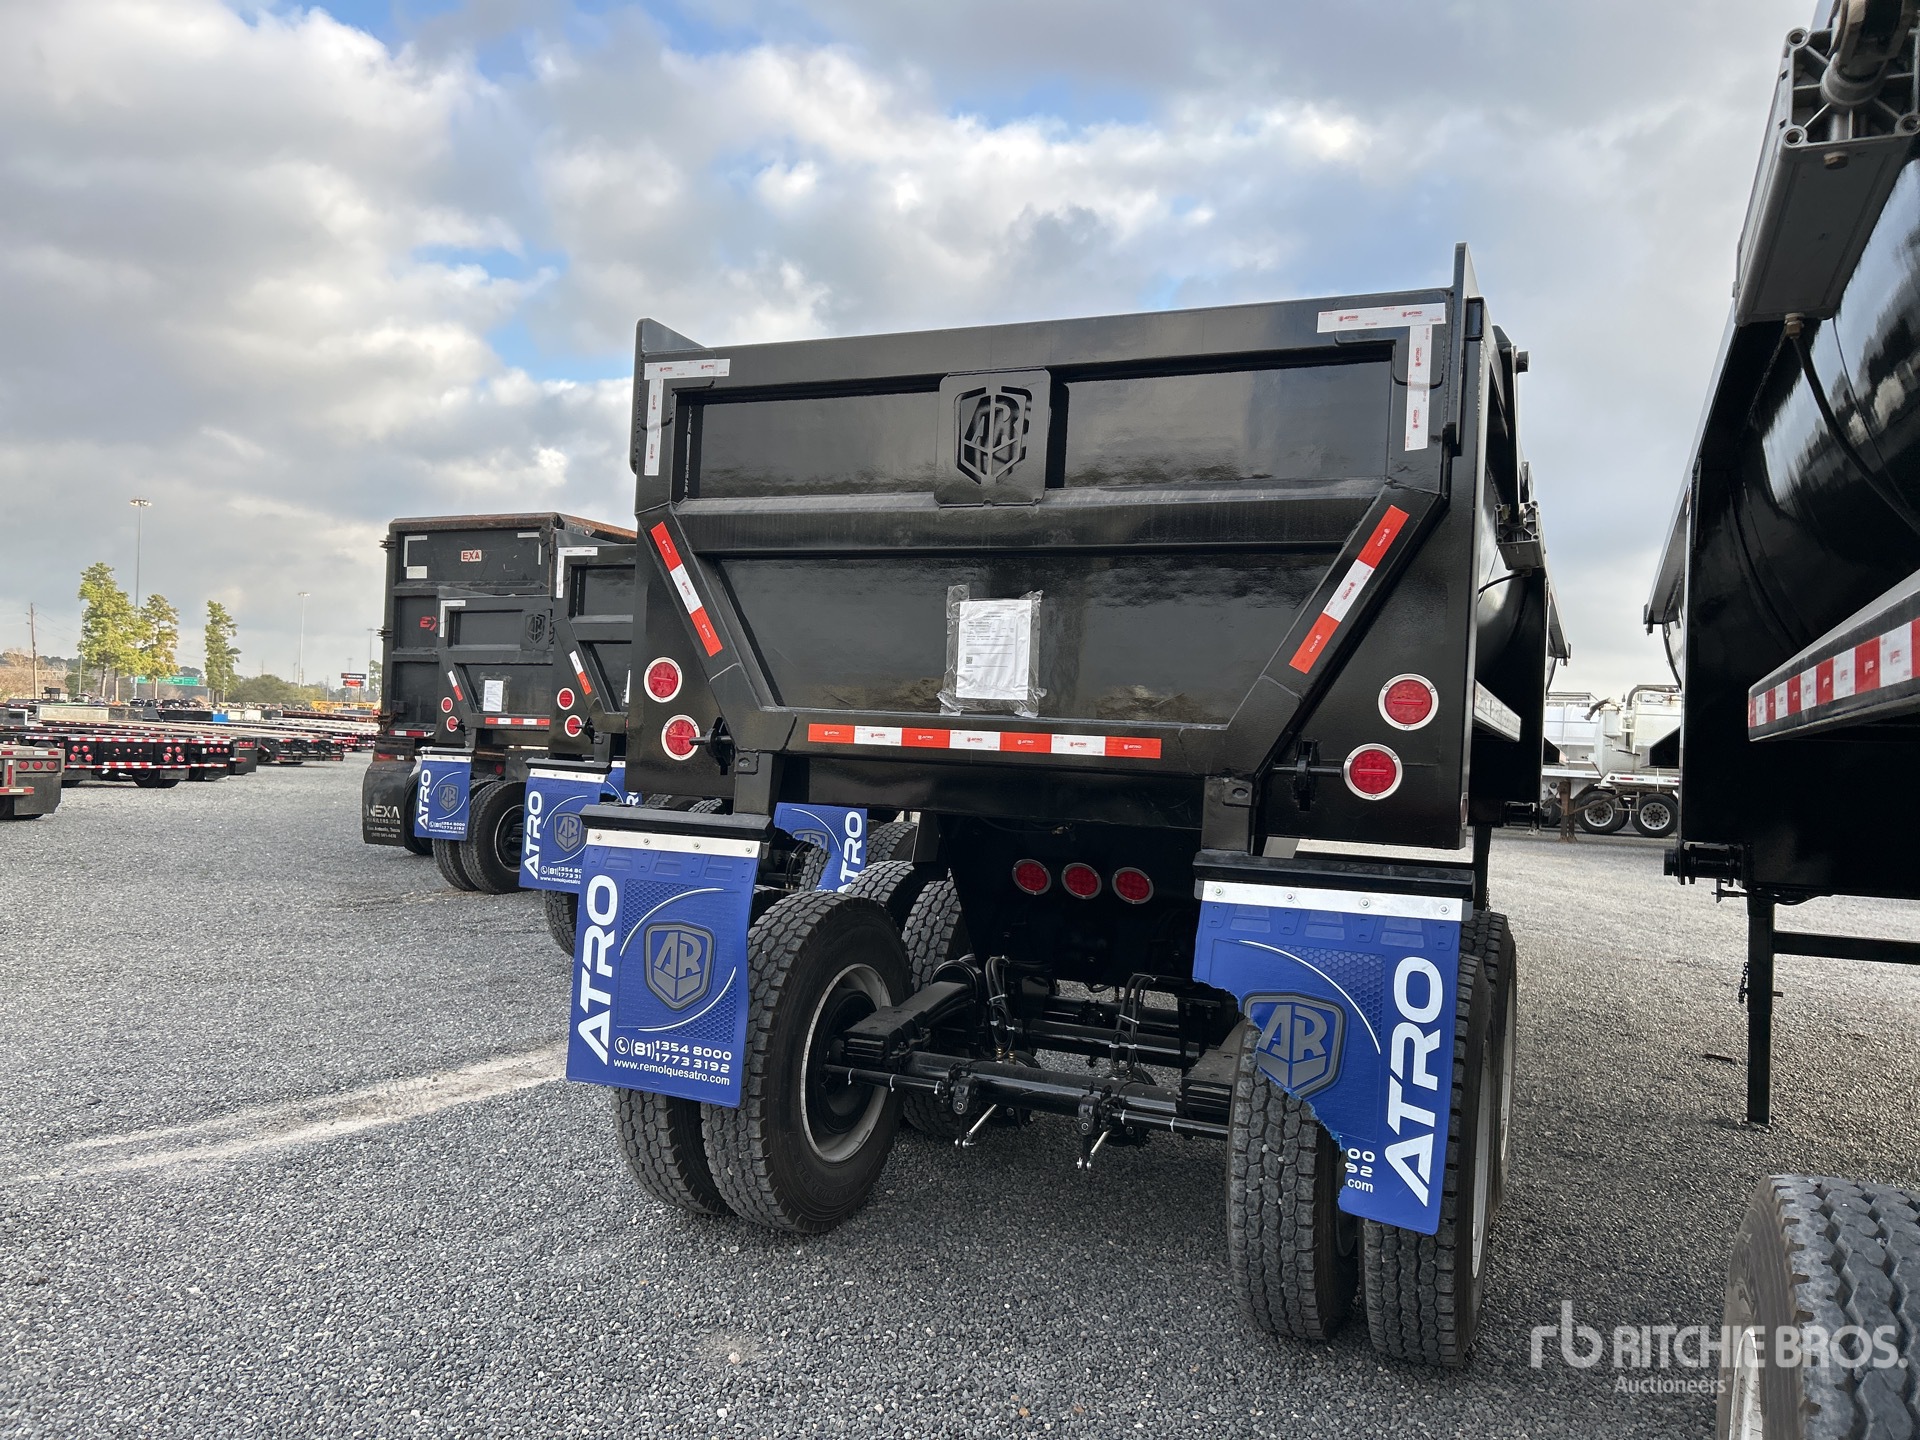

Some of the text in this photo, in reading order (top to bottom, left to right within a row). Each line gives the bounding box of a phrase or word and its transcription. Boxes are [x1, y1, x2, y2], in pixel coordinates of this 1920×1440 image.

[462, 549, 481, 562] EXA
[366, 804, 400, 819] NEXA
[417, 769, 432, 831] ATRO
[523, 790, 543, 880] ATRO
[547, 866, 559, 876] (81)
[577, 874, 618, 1066] ATRO
[630, 1038, 733, 1061] (81) 1354 8000
[613, 1058, 731, 1086] www.remolquesatro.com
[655, 1052, 731, 1074] 1773 3192
[1384, 955, 1444, 1207] ATRO
[1347, 1178, 1374, 1194] com
